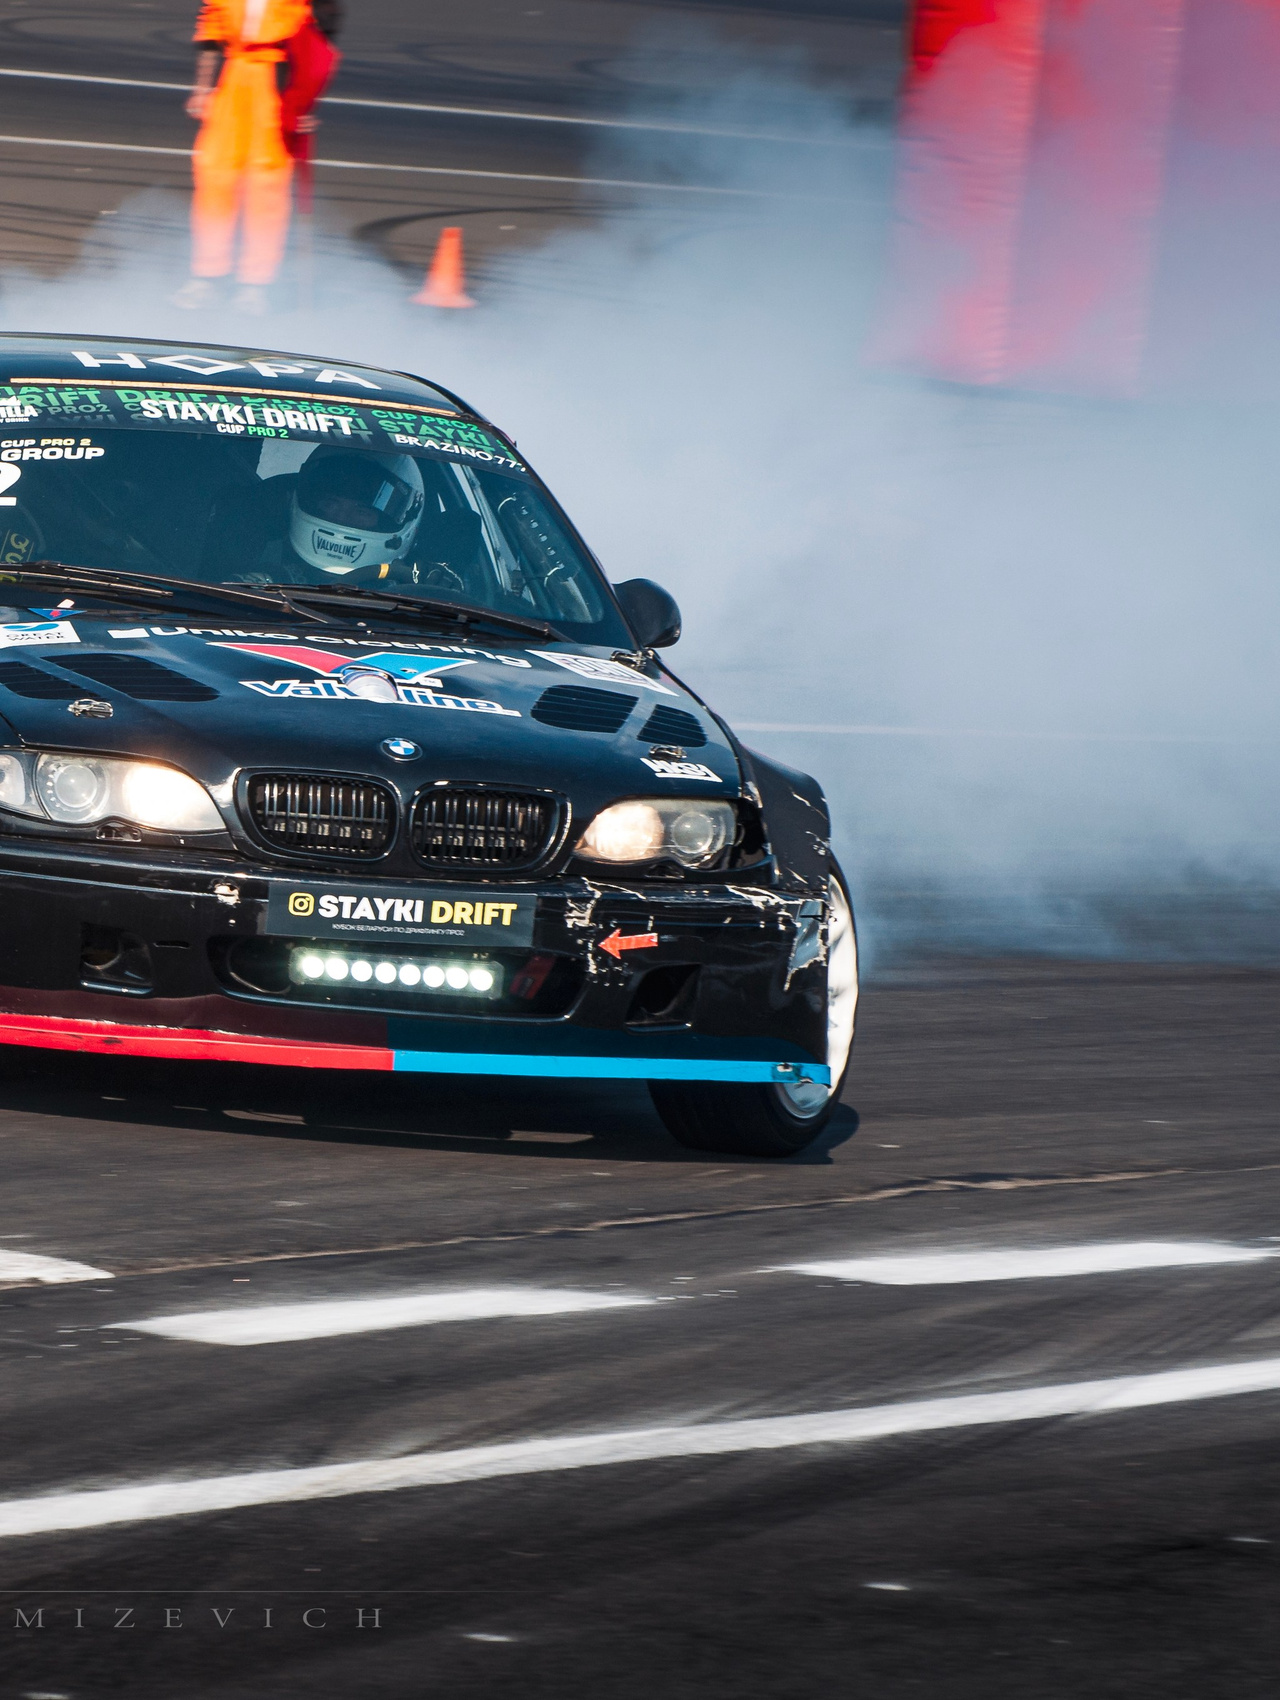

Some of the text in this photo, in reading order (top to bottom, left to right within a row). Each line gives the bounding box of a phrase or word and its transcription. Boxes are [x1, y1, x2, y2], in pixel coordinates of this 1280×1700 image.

[140, 399, 256, 425] STAYKI
[262, 408, 352, 435] DRIFT
[371, 409, 482, 432] CUP PRO2
[216, 422, 245, 434] CUP
[247, 425, 275, 437] PRO
[279, 428, 290, 438] 2
[378, 420, 491, 446] STAYKI
[0, 447, 105, 461] GROUP
[1, 438, 91, 448] CUP PRO 2
[316, 536, 357, 558] VALVOLINE
[318, 894, 518, 926] STAYKI DRIFT
